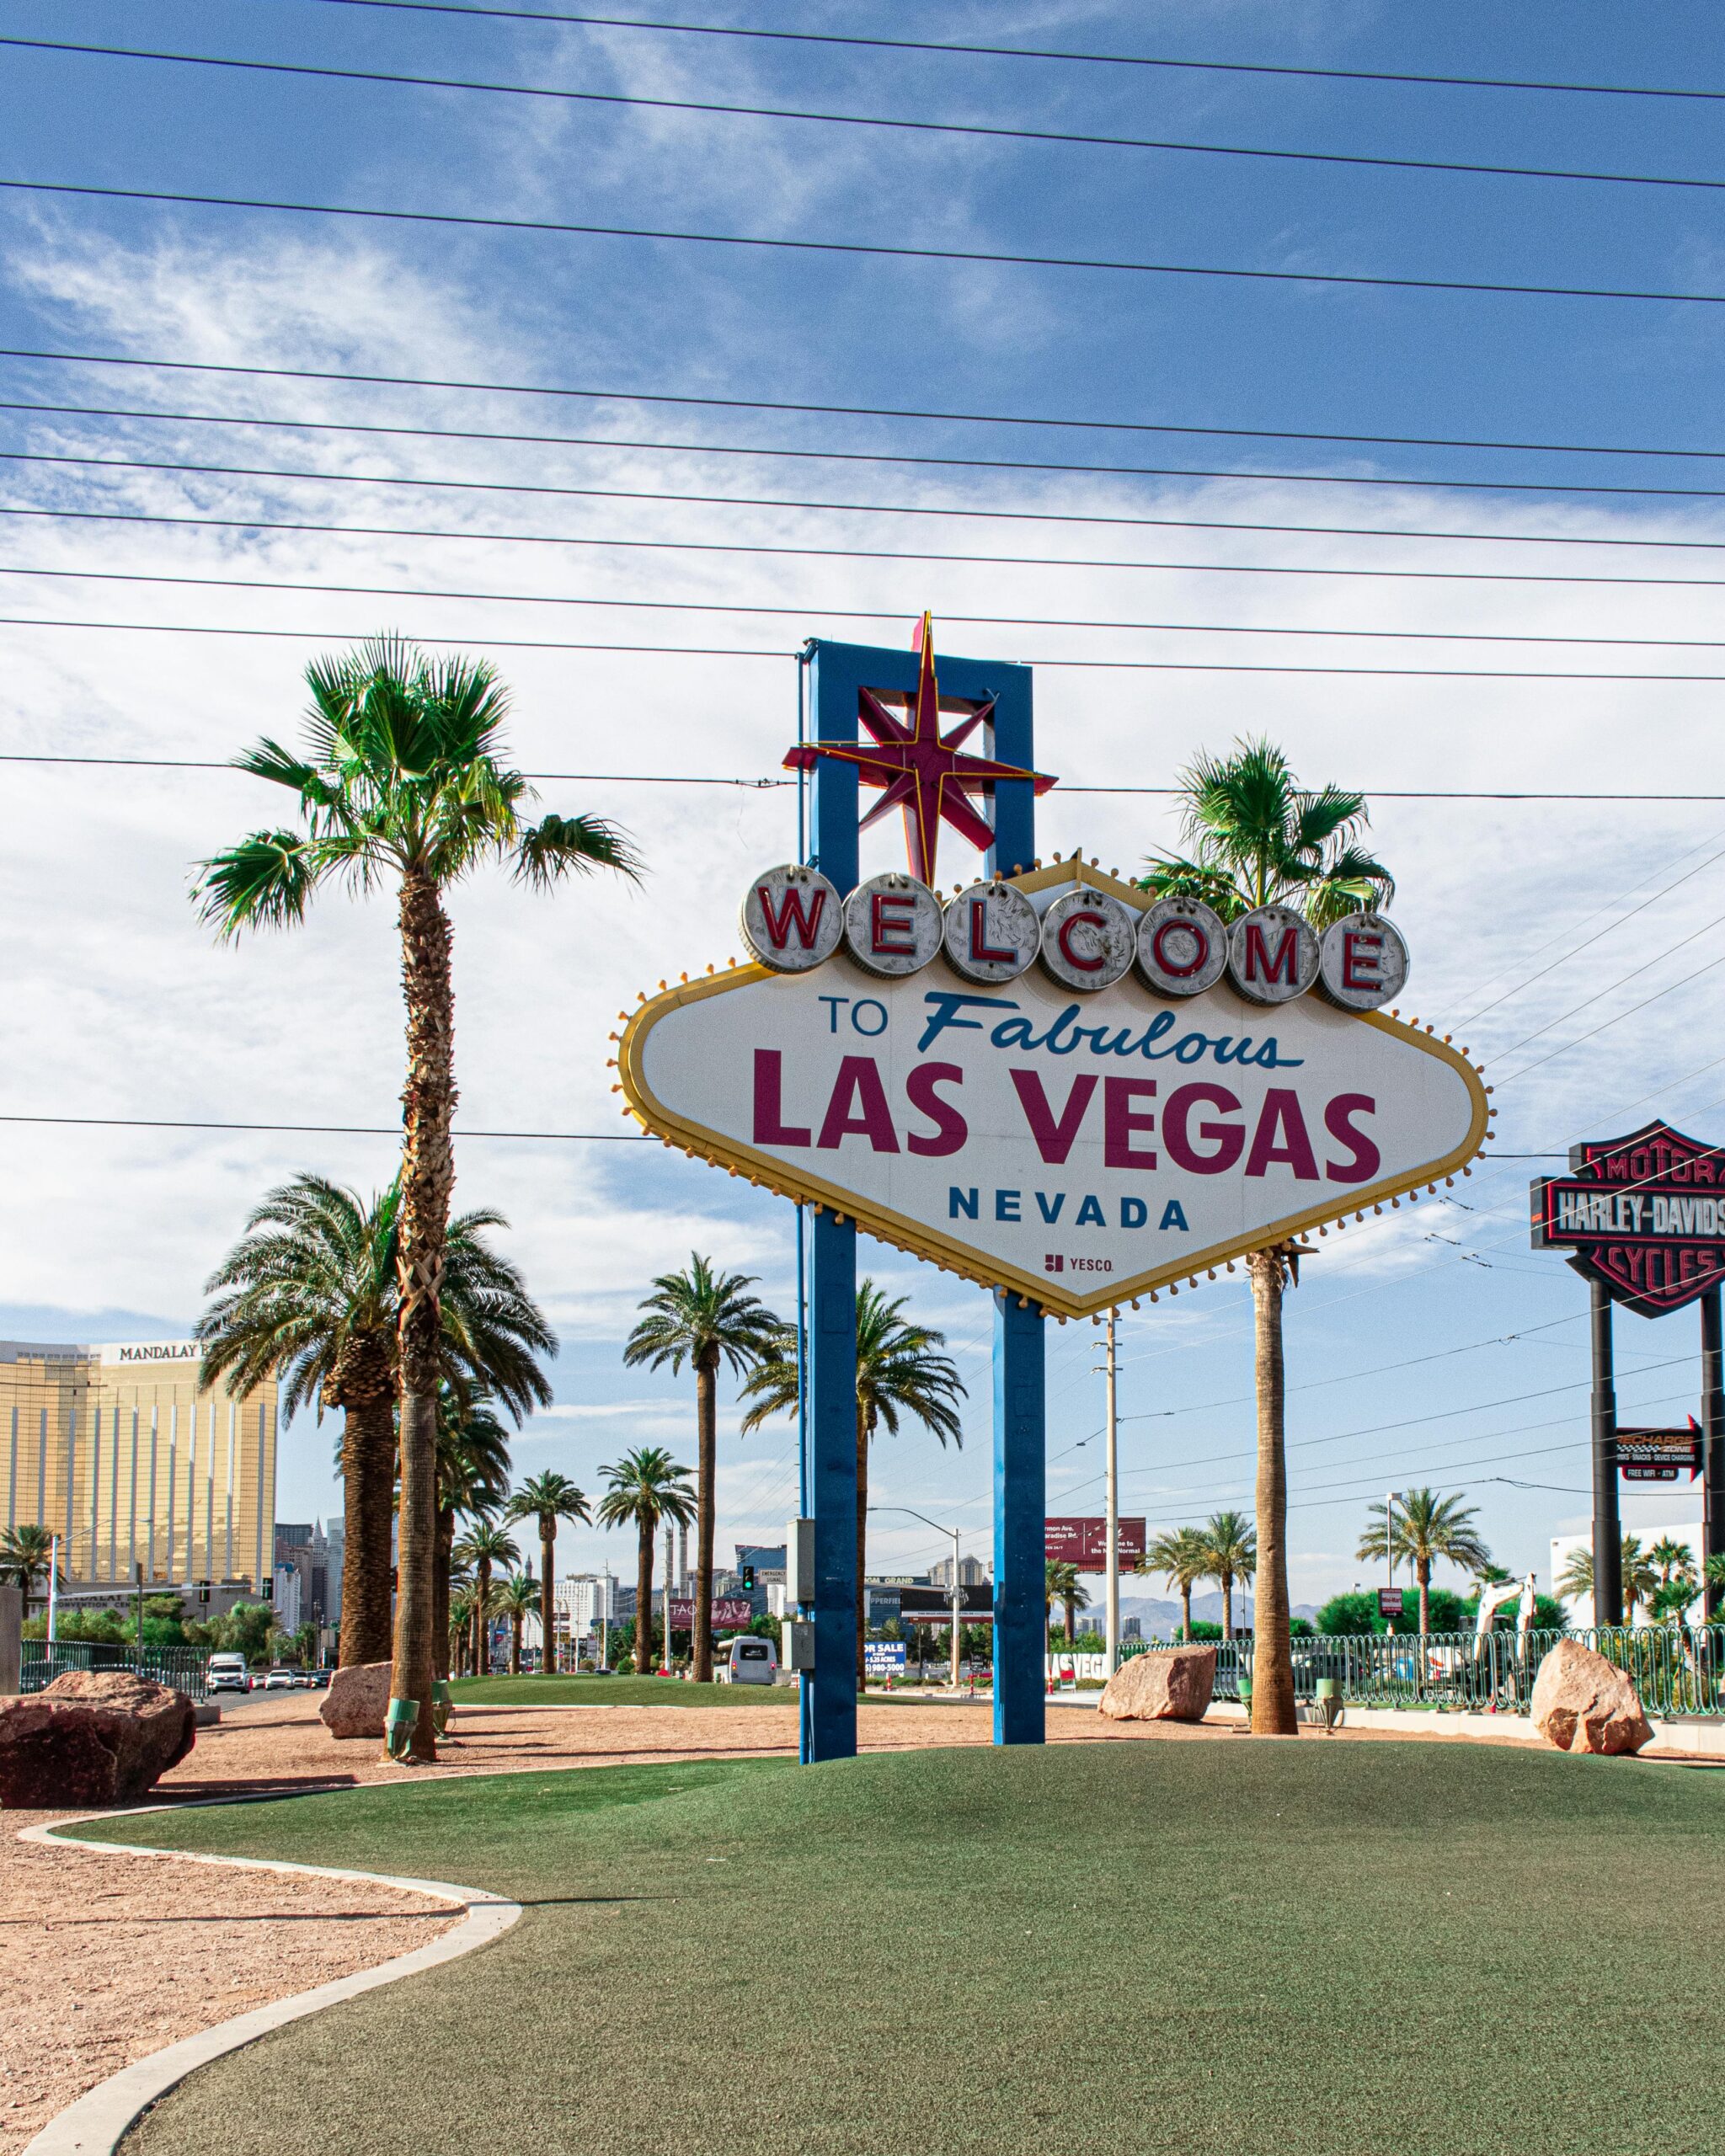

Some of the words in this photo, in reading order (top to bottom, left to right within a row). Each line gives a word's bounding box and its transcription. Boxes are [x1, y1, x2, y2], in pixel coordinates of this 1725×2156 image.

[758, 886, 1385, 990] WELCOME
[818, 995, 889, 1037] TO
[916, 991, 1306, 1068] Fabulous
[753, 1049, 969, 1158] LAS
[1008, 1067, 1381, 1184] VEGAS
[1606, 1138, 1717, 1184] MOTOR
[948, 1187, 1190, 1232] NEVADA
[1607, 1246, 1717, 1296] CYCLES
[120, 1345, 197, 1361] MANDALAY
[1627, 1469, 1642, 1477] FREE
[670, 1604, 697, 1616] TAO
[872, 1663, 905, 1672] 980-5000
[878, 1643, 904, 1652] SALE
